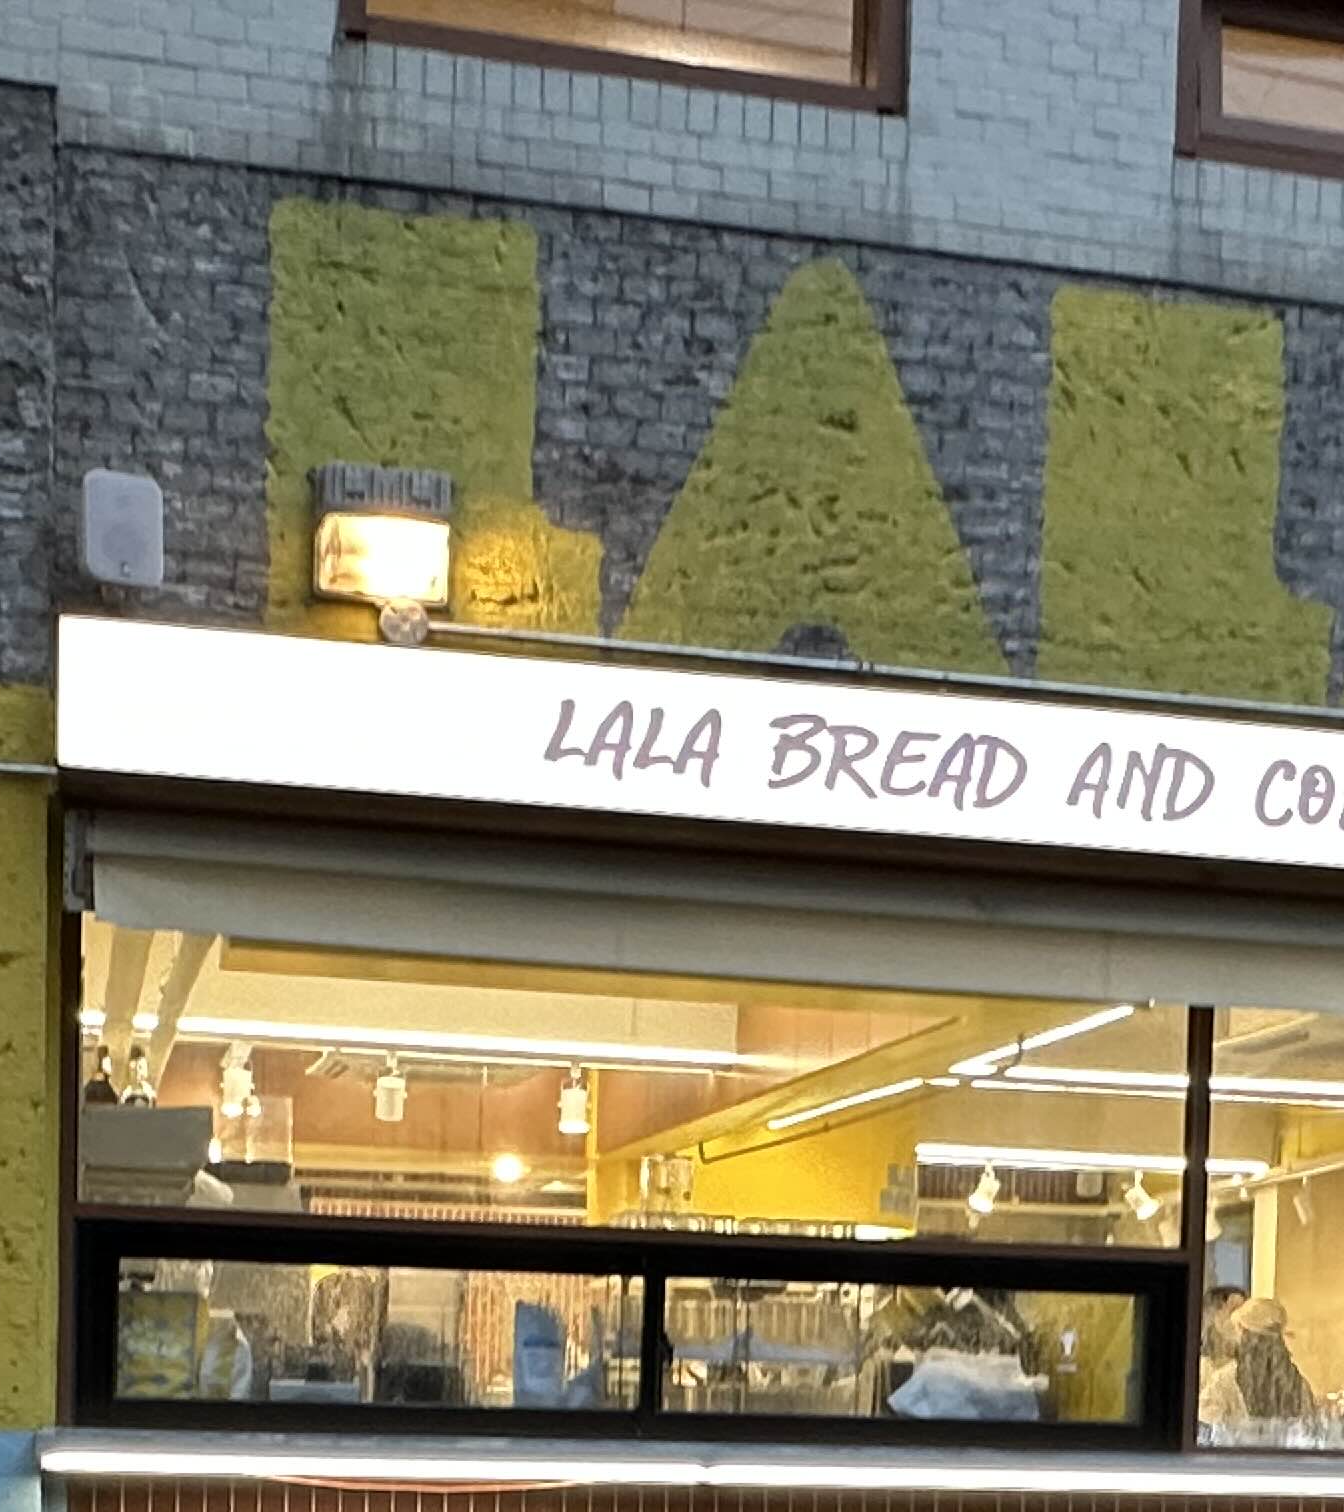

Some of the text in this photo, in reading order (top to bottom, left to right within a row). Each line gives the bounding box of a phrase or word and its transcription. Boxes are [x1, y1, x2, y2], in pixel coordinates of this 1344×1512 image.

[544, 698, 724, 788] LALA
[768, 714, 1028, 811] BREAD
[1067, 742, 1216, 824] AND
